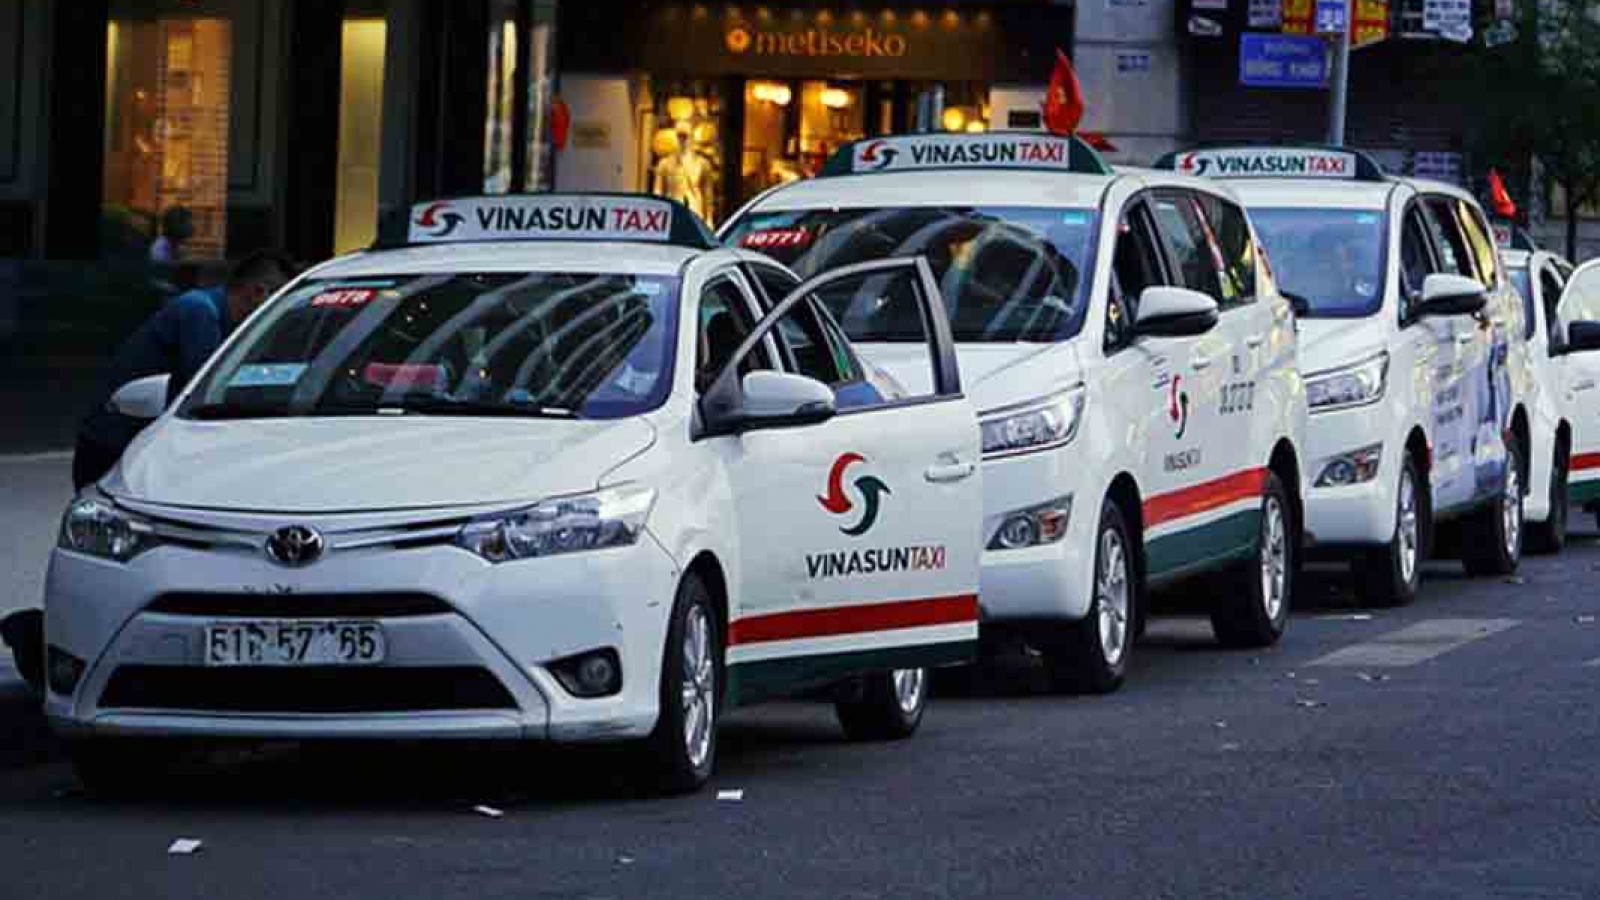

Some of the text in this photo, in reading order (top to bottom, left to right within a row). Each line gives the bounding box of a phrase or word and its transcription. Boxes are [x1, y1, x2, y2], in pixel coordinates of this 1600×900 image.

[756, 28, 906, 57] metiseko
[476, 205, 669, 232] VINASUN TAXI
